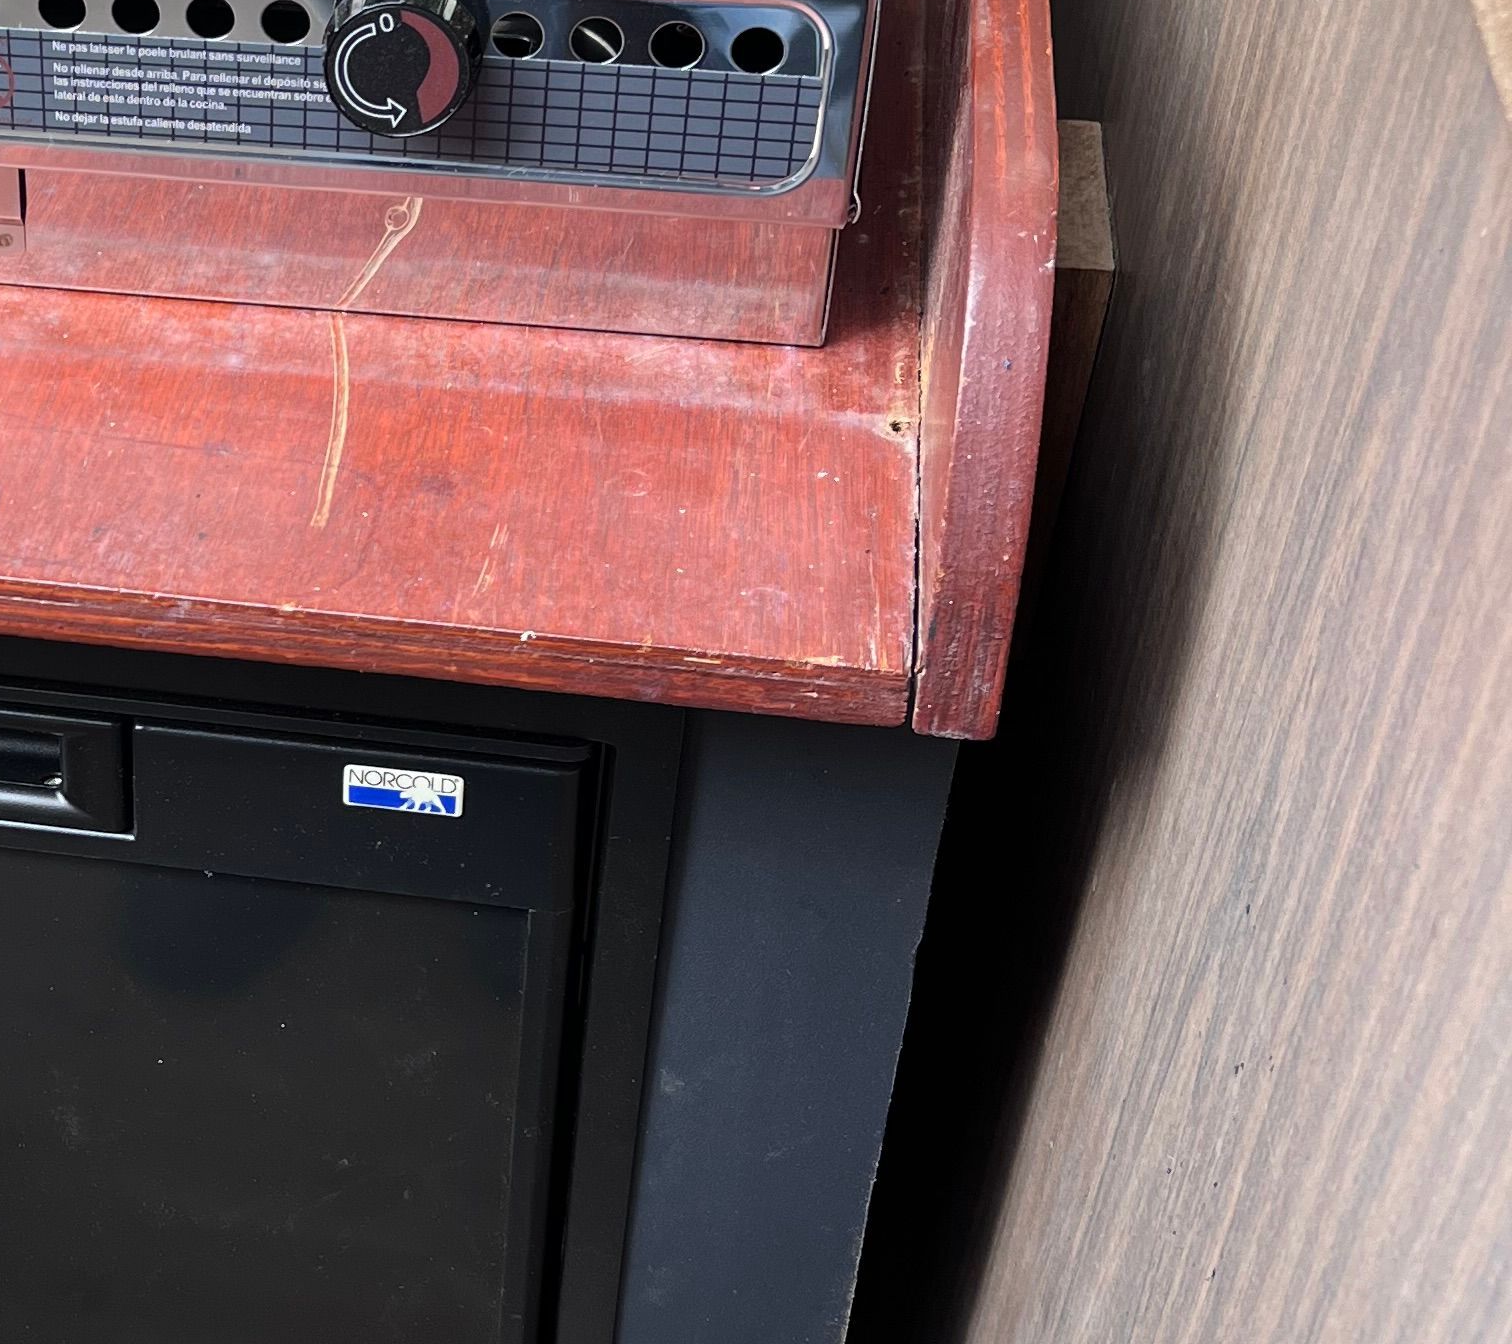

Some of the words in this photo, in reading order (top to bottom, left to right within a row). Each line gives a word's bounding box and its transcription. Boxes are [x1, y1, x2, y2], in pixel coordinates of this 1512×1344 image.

[52, 40, 67, 52] Ne
[68, 43, 88, 54] pas
[89, 43, 125, 55] laisser
[126, 45, 136, 55] le
[208, 50, 235, 62] sans
[236, 52, 302, 66] surveillance
[53, 62, 68, 73] No
[69, 63, 110, 76] rellenar
[111, 66, 145, 78] desde
[182, 70, 207, 82] Para
[208, 72, 250, 86] rellenar
[251, 75, 262, 85] el
[312, 78, 329, 93] sig
[53, 75, 68, 86] las
[70, 76, 140, 91] instrucciones
[141, 81, 158, 92] del
[158, 82, 195, 95] relleno
[196, 86, 217, 98] que
[217, 87, 231, 97] se
[232, 88, 292, 101] encuentran
[293, 91, 324, 103] sobre
[53, 89, 87, 102] lateral
[87, 91, 101, 103] de
[102, 93, 126, 104] este
[126, 94, 162, 106] dentro
[162, 96, 177, 107] de
[177, 97, 188, 108] la
[189, 98, 228, 111] cocina.
[54, 110, 70, 122] No
[71, 112, 98, 125] dejar
[99, 113, 109, 125] la
[110, 115, 144, 127] estufa
[144, 117, 186, 130] caliente
[187, 119, 252, 134] desatendida
[348, 768, 458, 795] NORCOLD
